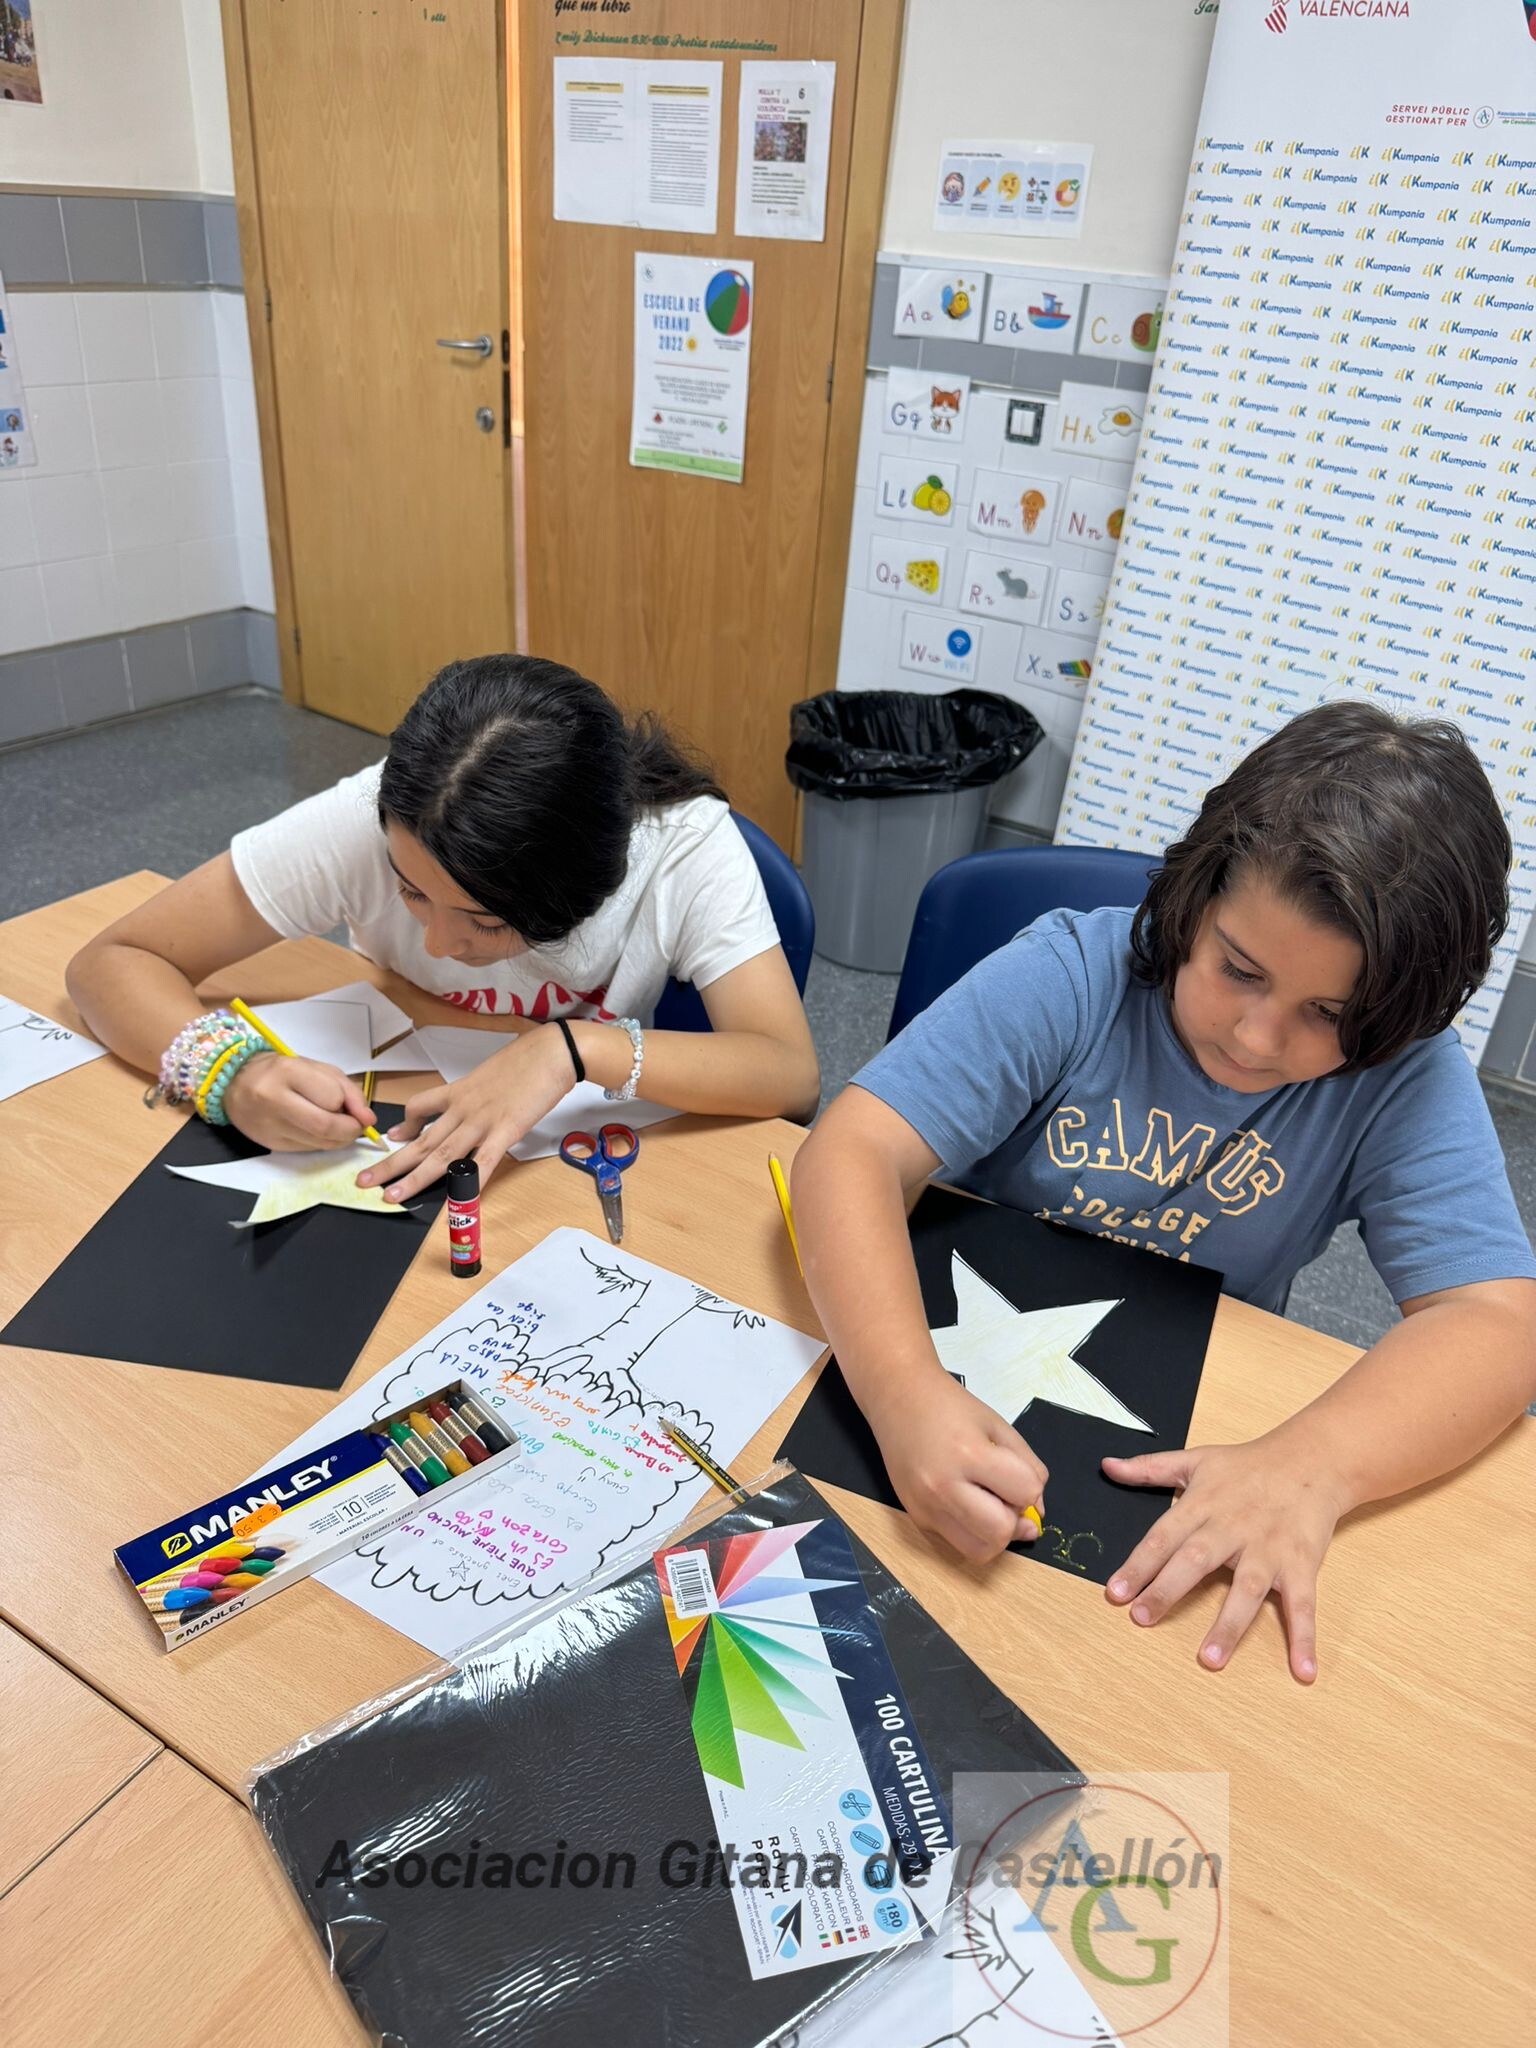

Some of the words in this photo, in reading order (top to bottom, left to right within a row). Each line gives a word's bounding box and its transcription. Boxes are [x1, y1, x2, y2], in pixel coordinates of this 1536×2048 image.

[581, 2, 597, 12] un
[1299, 1, 1410, 17] VALENCIANA
[1385, 115, 1443, 125] GESTIONAT
[1446, 118, 1467, 127] PER
[1392, 104, 1428, 114] SERVEI
[1431, 105, 1470, 116] PÚBLIC
[643, 294, 685, 311] ESCUELA
[688, 297, 700, 312] DE
[653, 315, 689, 332] VERANO
[189, 1458, 333, 1545] MANLEY
[342, 1501, 362, 1517] 10
[338, 1520, 363, 1535] MATERIAL
[362, 1509, 385, 1523] ESCOLAR
[427, 1511, 472, 1538] MUCHO
[509, 1557, 536, 1578] QUE
[186, 1598, 246, 1636] MANLEY
[874, 1693, 905, 1731] 100
[883, 1786, 909, 1840] MEDIDAS:
[752, 1840, 775, 1899] Paper
[768, 1836, 791, 1893] Raylu
[827, 1820, 845, 1860] COLORED
[841, 1860, 864, 1922] CARDBOARDS
[805, 1882, 825, 1931] COLORATO
[822, 1891, 838, 1928] KARTON
[886, 1902, 902, 1928] 180
